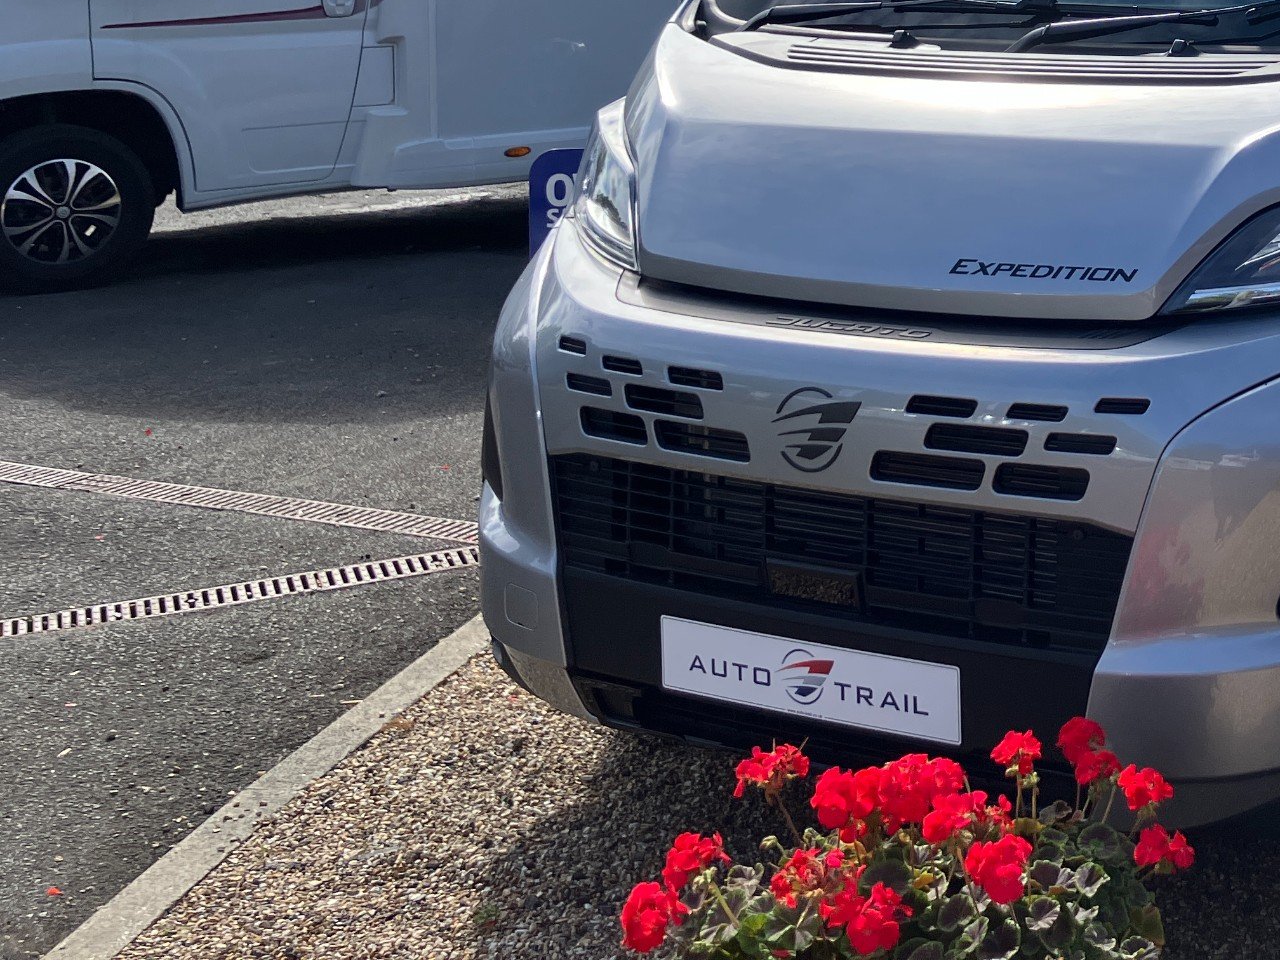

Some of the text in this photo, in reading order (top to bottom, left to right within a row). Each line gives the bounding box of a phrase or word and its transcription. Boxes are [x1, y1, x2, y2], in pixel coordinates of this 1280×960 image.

[948, 258, 1139, 283] EXPEDITION
[766, 315, 933, 339] DUCATO
[689, 654, 929, 717] AUTO TRAIL
